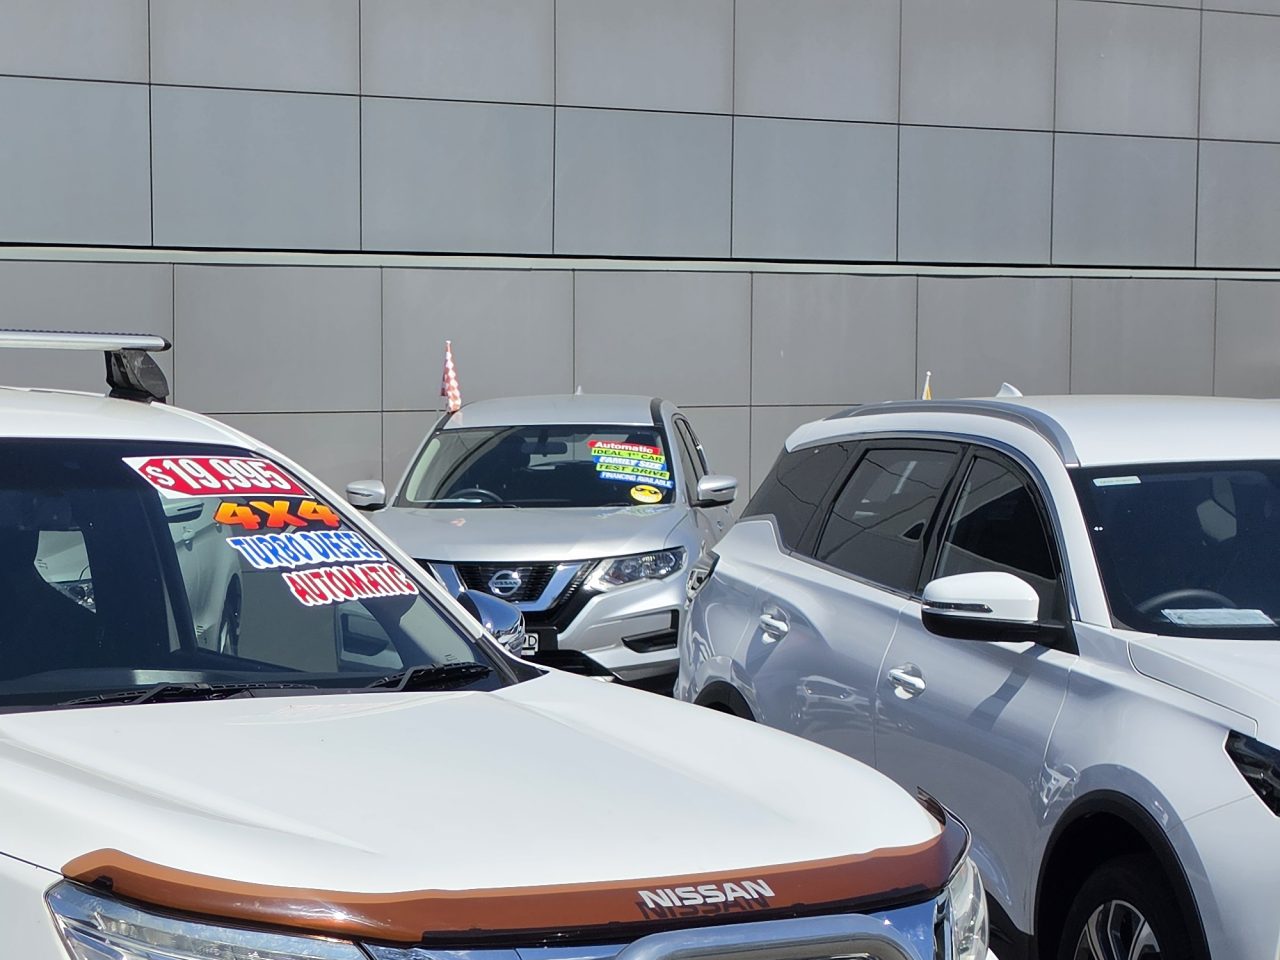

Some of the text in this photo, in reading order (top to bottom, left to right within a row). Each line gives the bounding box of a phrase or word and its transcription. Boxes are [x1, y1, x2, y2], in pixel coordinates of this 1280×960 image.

[593, 449, 626, 457] IDEAL
[640, 455, 663, 463] CAR
[594, 441, 654, 454] Automatic
[146, 458, 292, 491] $19,995
[599, 464, 668, 478] TEST DRIVE
[231, 531, 383, 567] TURBO DIESEL
[287, 564, 416, 604] AUTOMATIC
[637, 879, 776, 909] NISSAN
